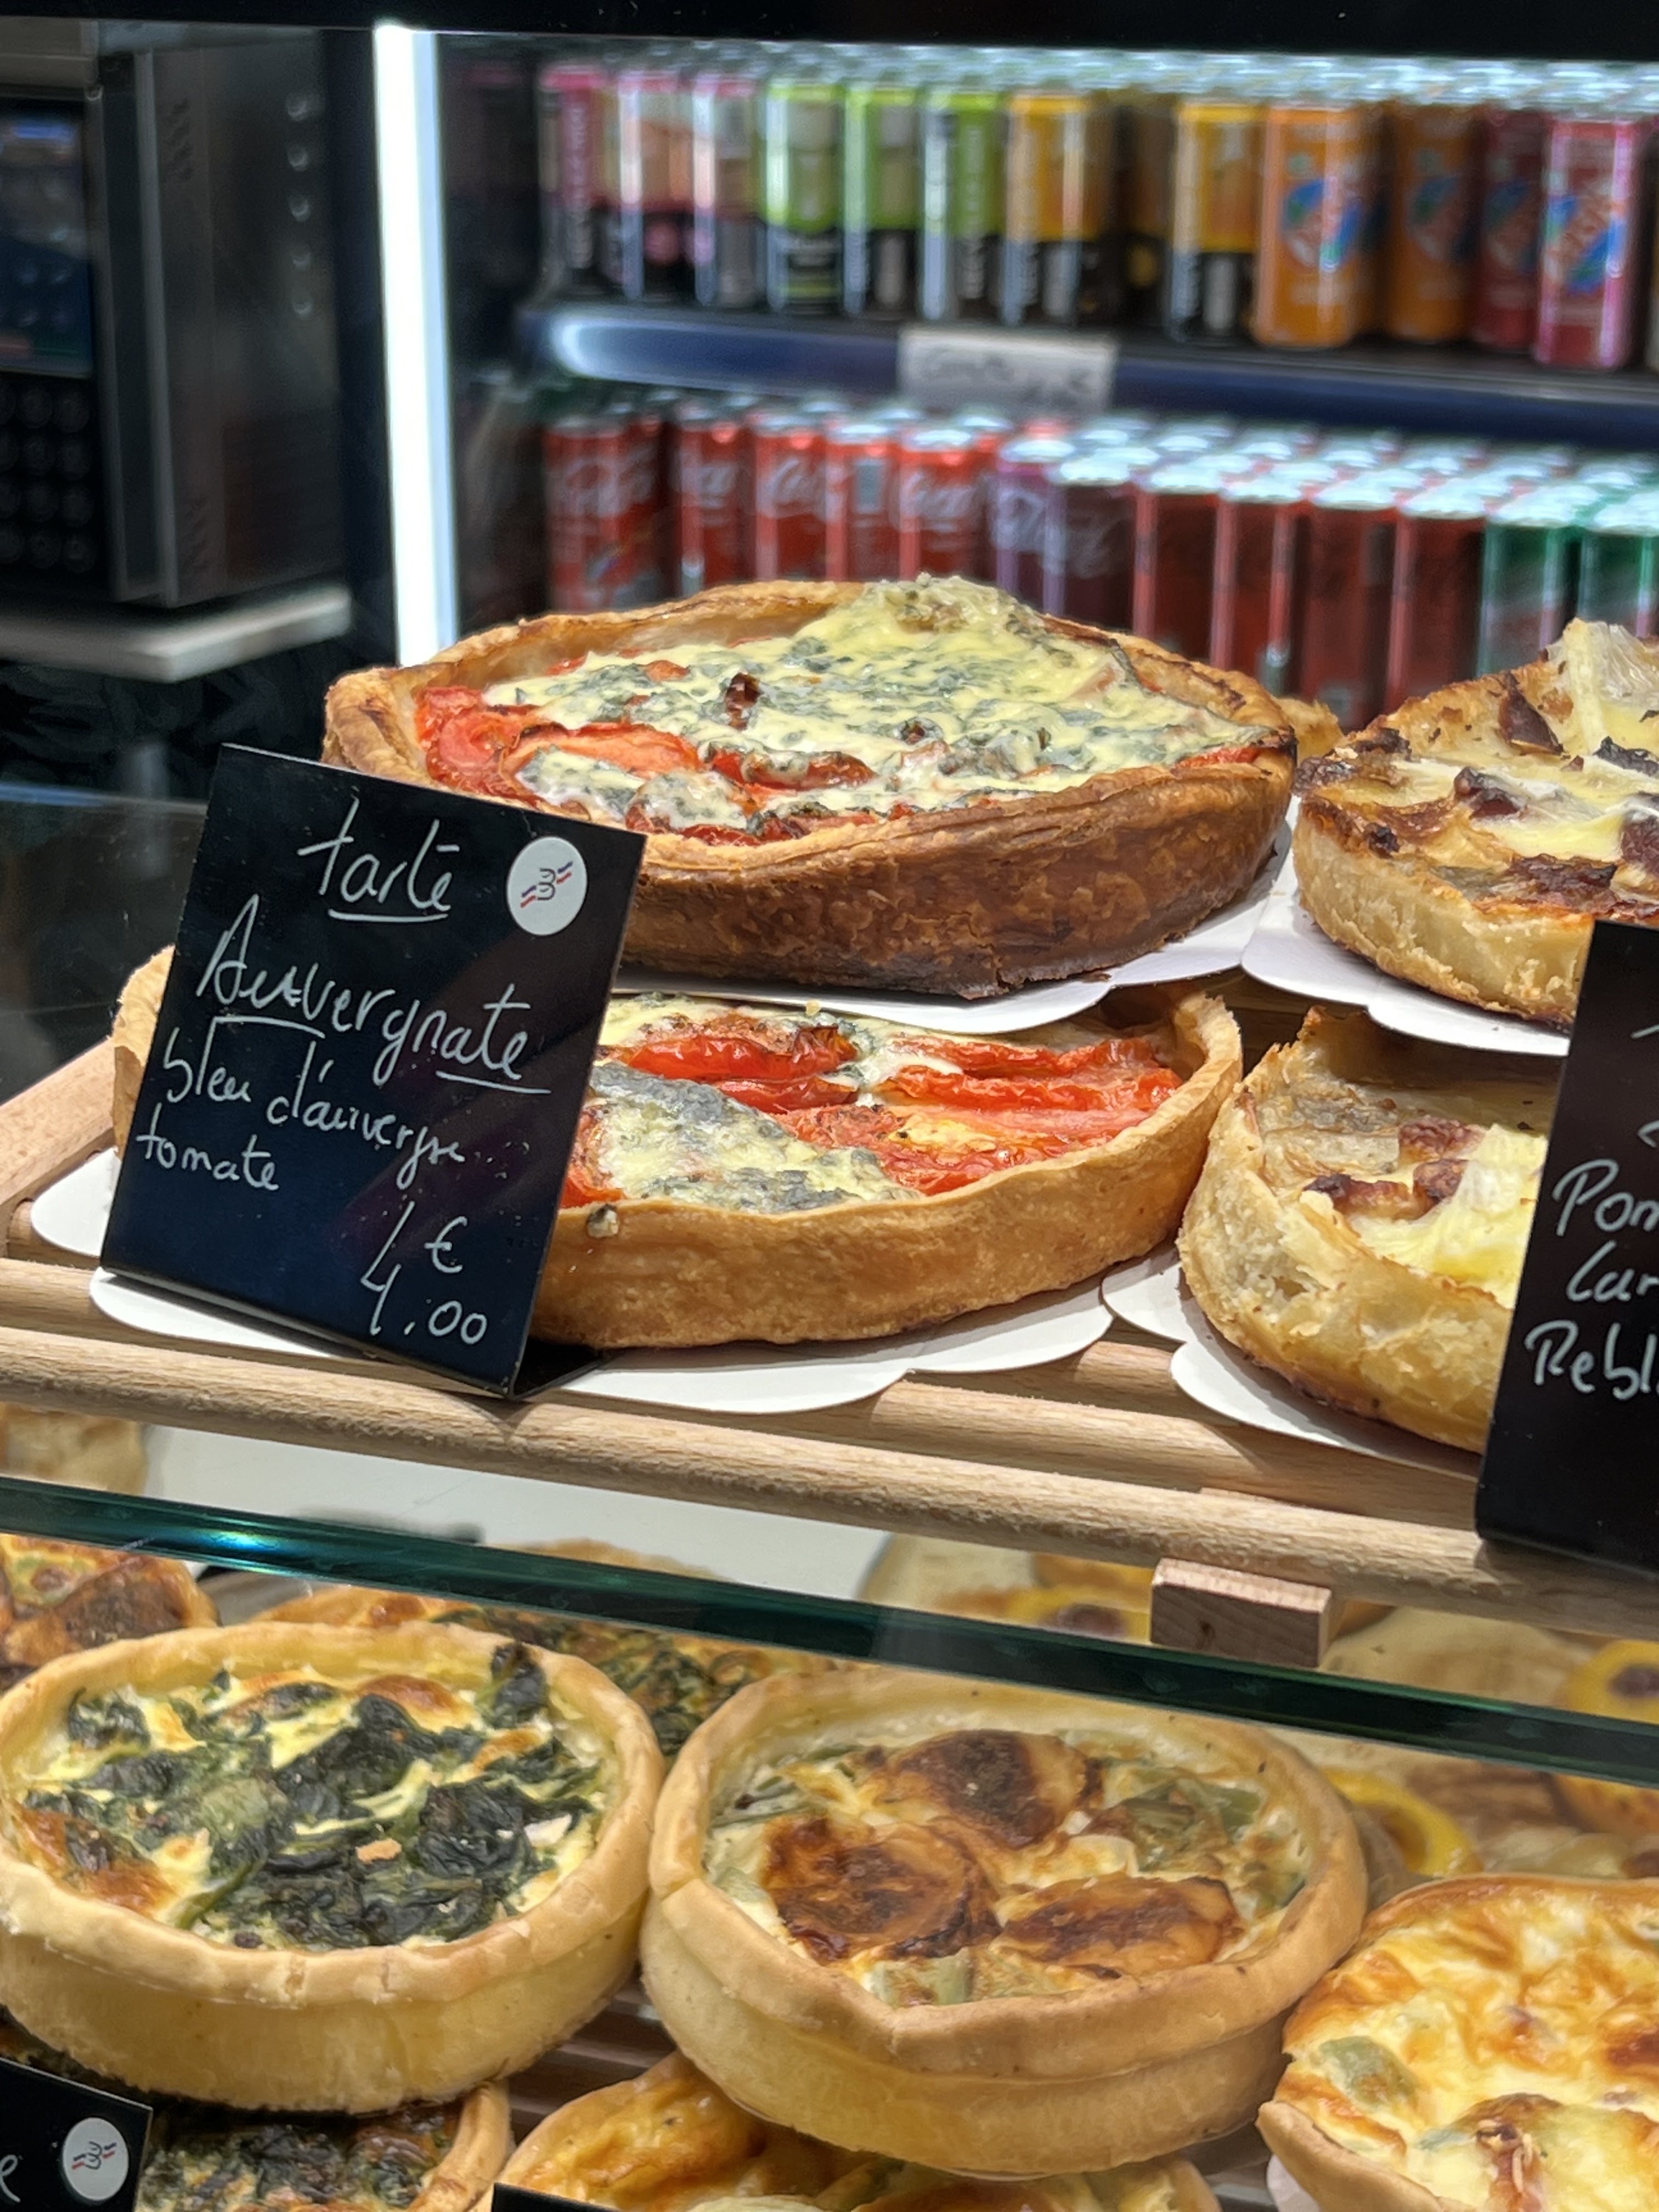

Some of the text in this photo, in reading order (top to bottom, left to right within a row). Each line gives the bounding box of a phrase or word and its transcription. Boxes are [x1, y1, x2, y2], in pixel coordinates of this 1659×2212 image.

[163, 1019, 251, 1103] bleu
[136, 1102, 279, 1190] tomate
[424, 1215, 468, 1274] €
[1523, 1319, 1659, 1401] Rebl
